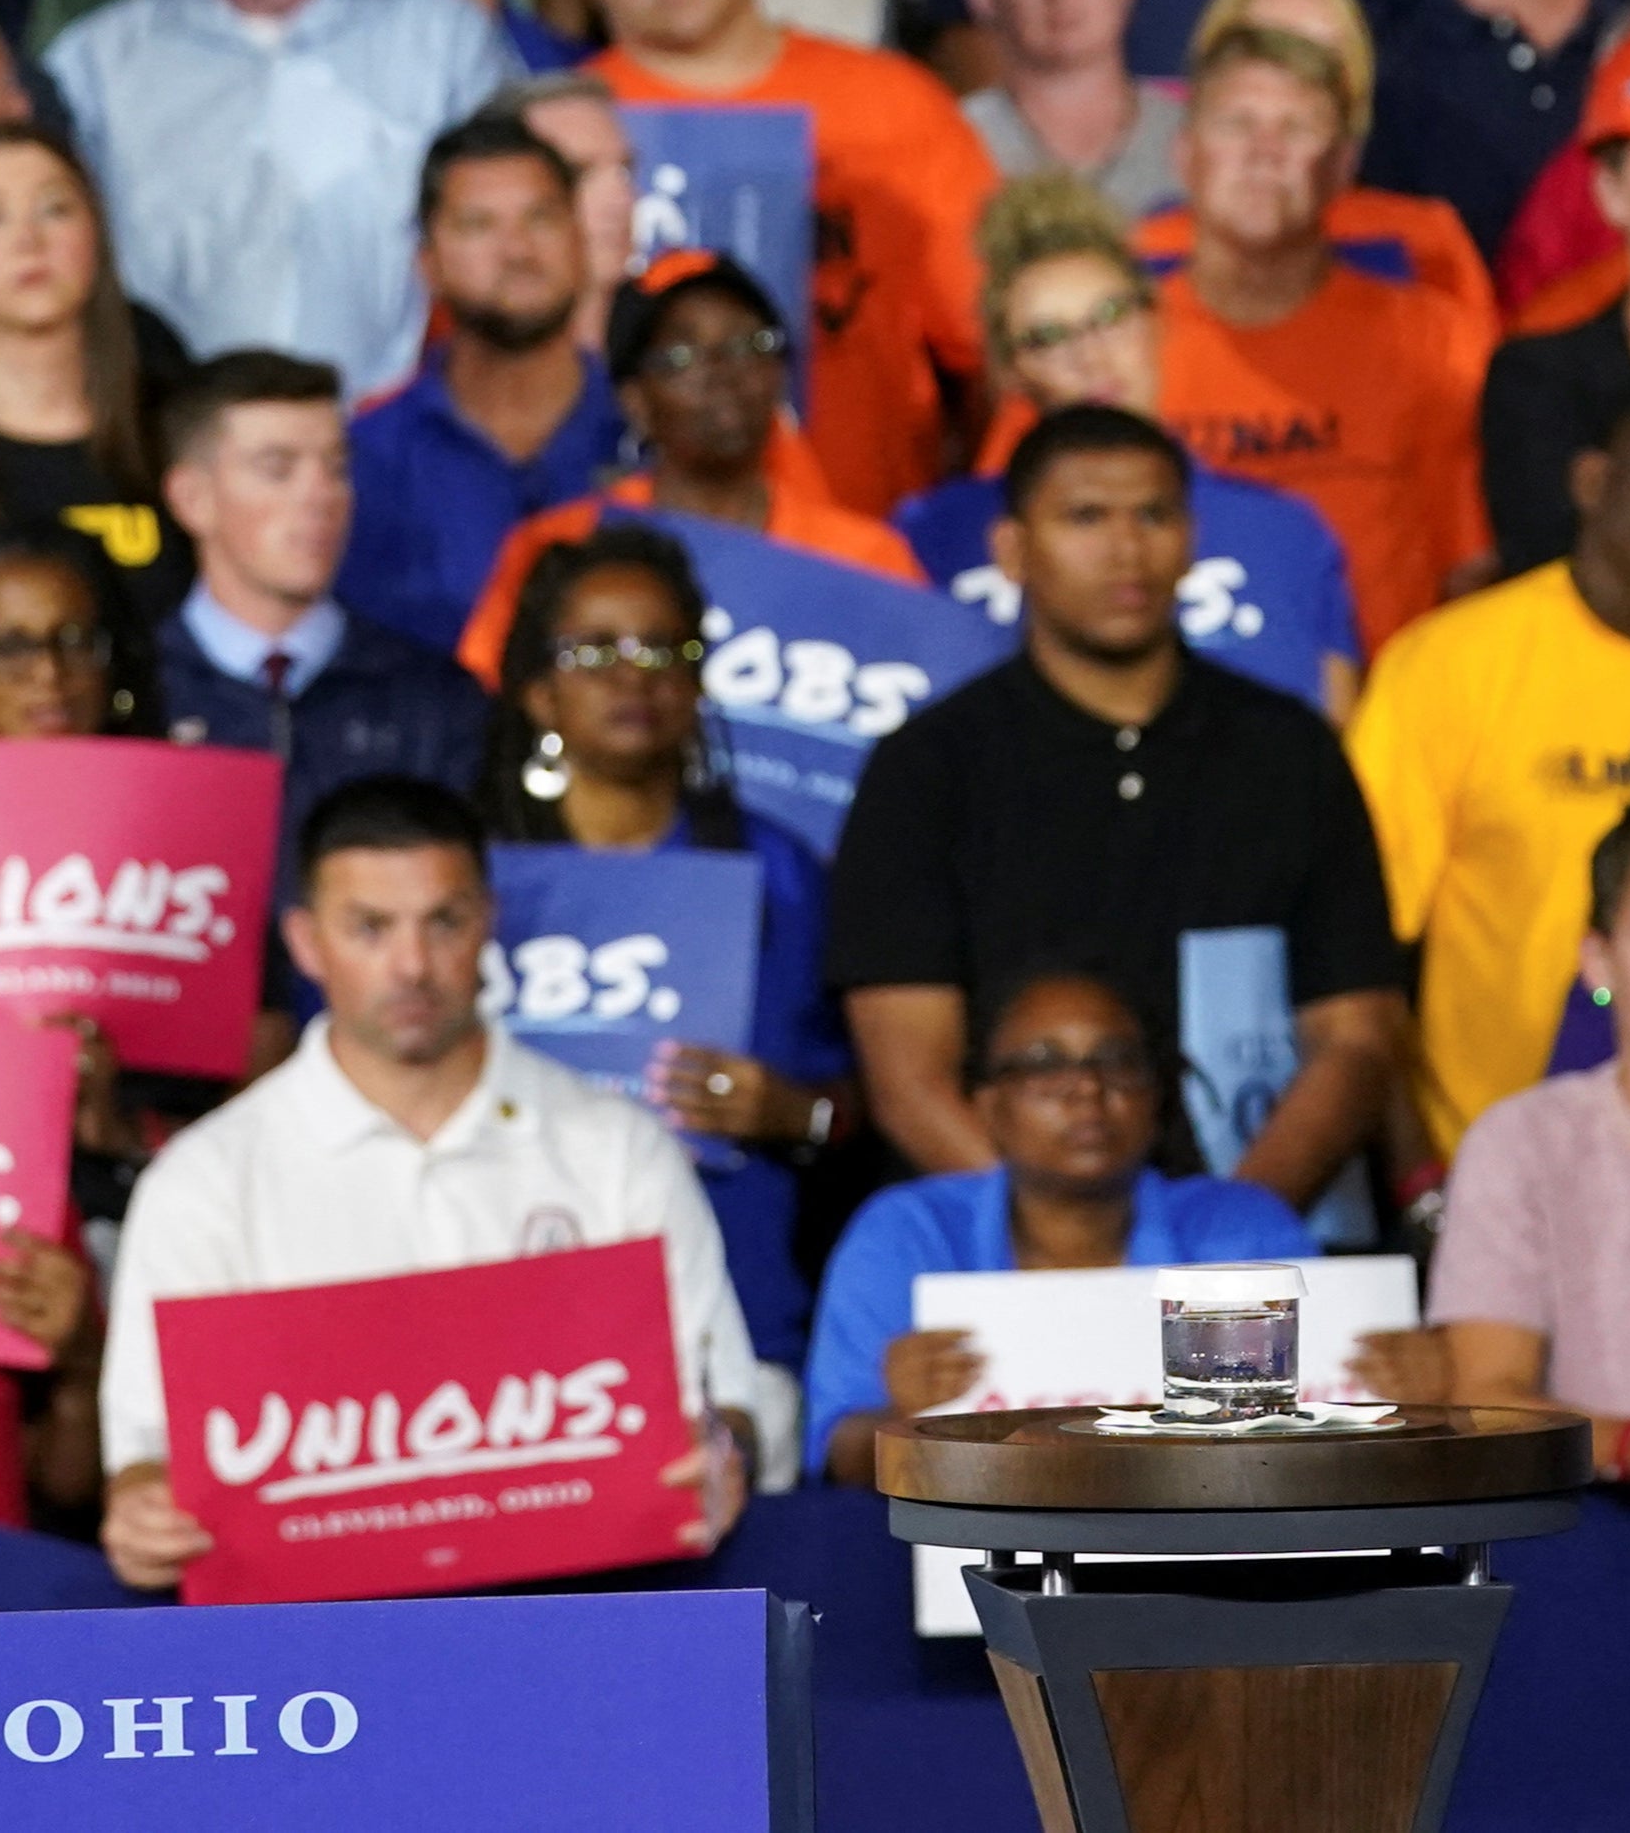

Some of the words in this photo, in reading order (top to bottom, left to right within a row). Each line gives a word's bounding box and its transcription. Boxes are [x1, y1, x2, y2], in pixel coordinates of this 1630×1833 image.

[203, 1358, 648, 1487] UNIONS.
[278, 1492, 496, 1543] CLEVELAND,
[497, 1478, 594, 1515] OHIO
[2, 1689, 360, 1764] OHIO
